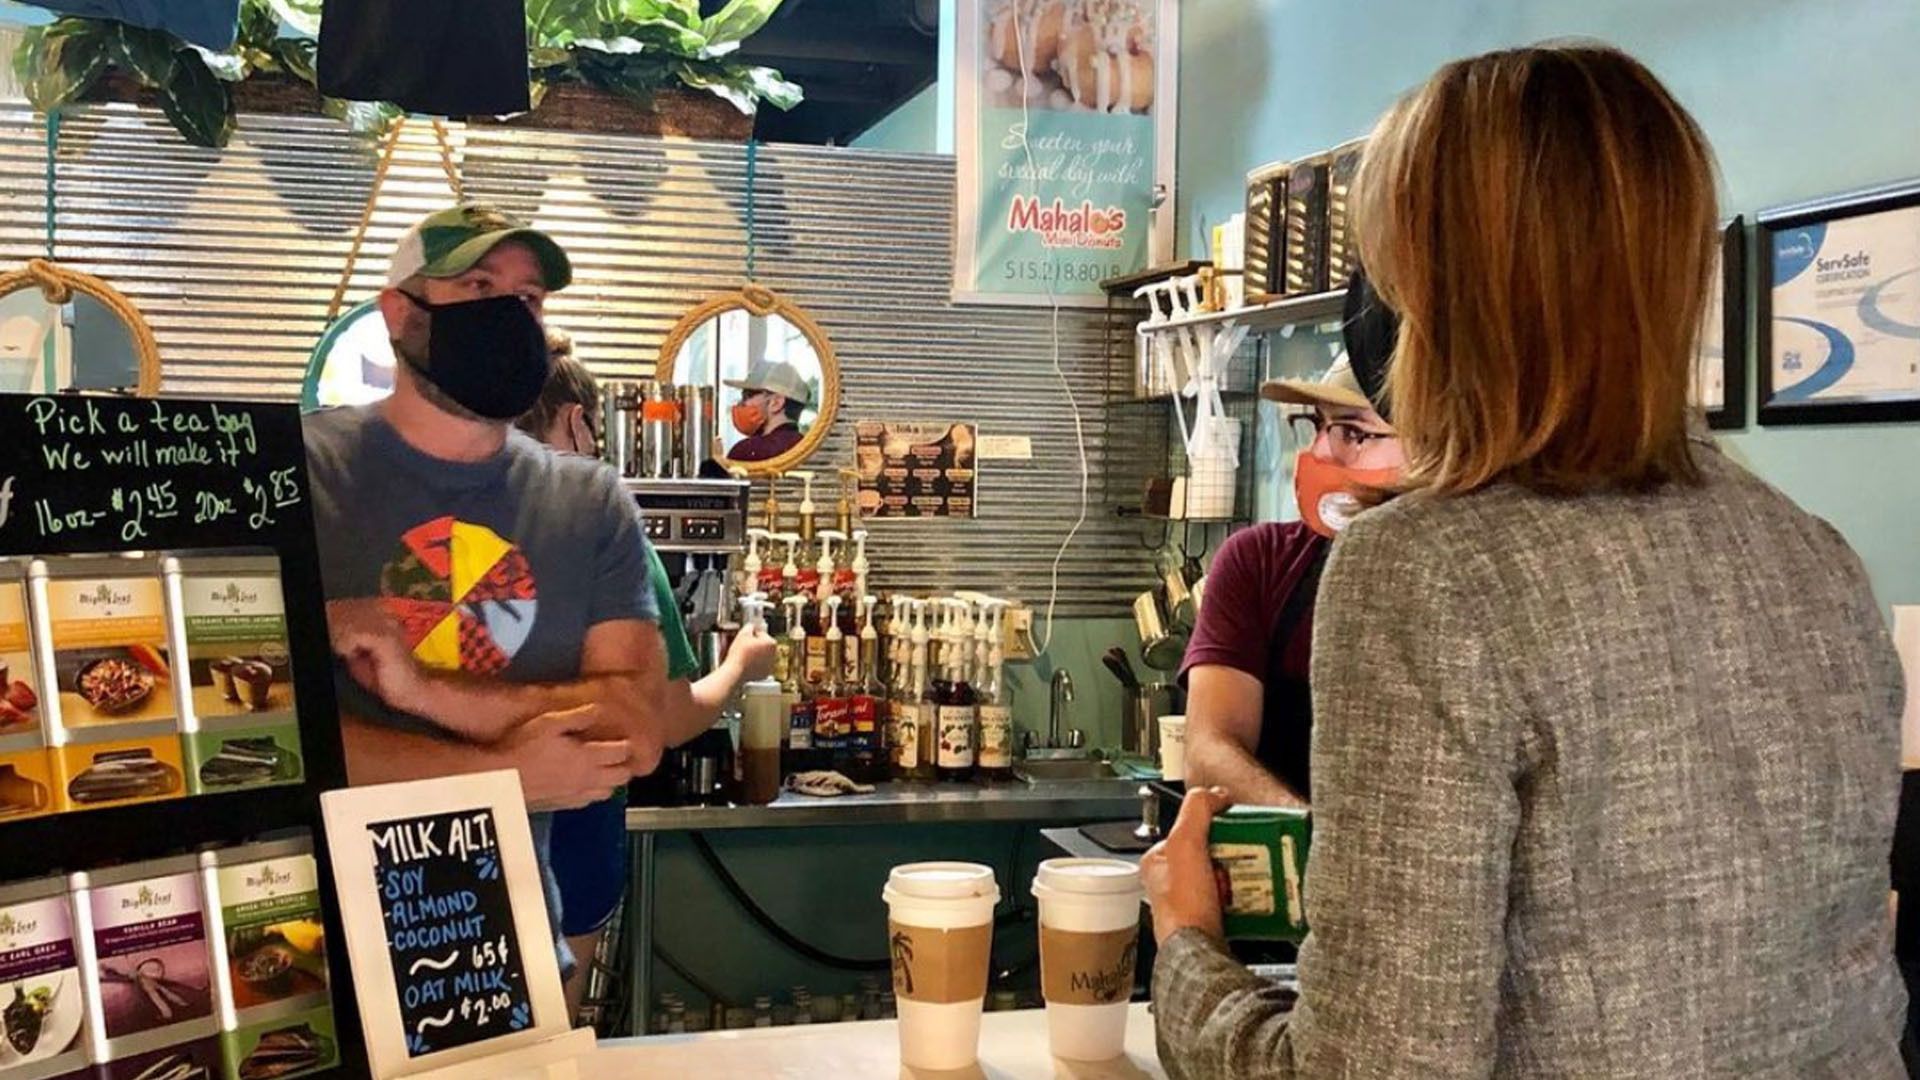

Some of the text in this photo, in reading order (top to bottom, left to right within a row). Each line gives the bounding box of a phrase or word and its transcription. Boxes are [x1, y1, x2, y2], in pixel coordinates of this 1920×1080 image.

[1008, 194, 1126, 234] Mahalo's
[1816, 250, 1870, 272] ServSafe
[26, 398, 257, 455] Pick a tea bag
[42, 431, 241, 470] We will make it
[368, 813, 494, 864] MILK ALT.
[404, 977, 446, 1009] OAT
[461, 992, 511, 1026] $2.00
